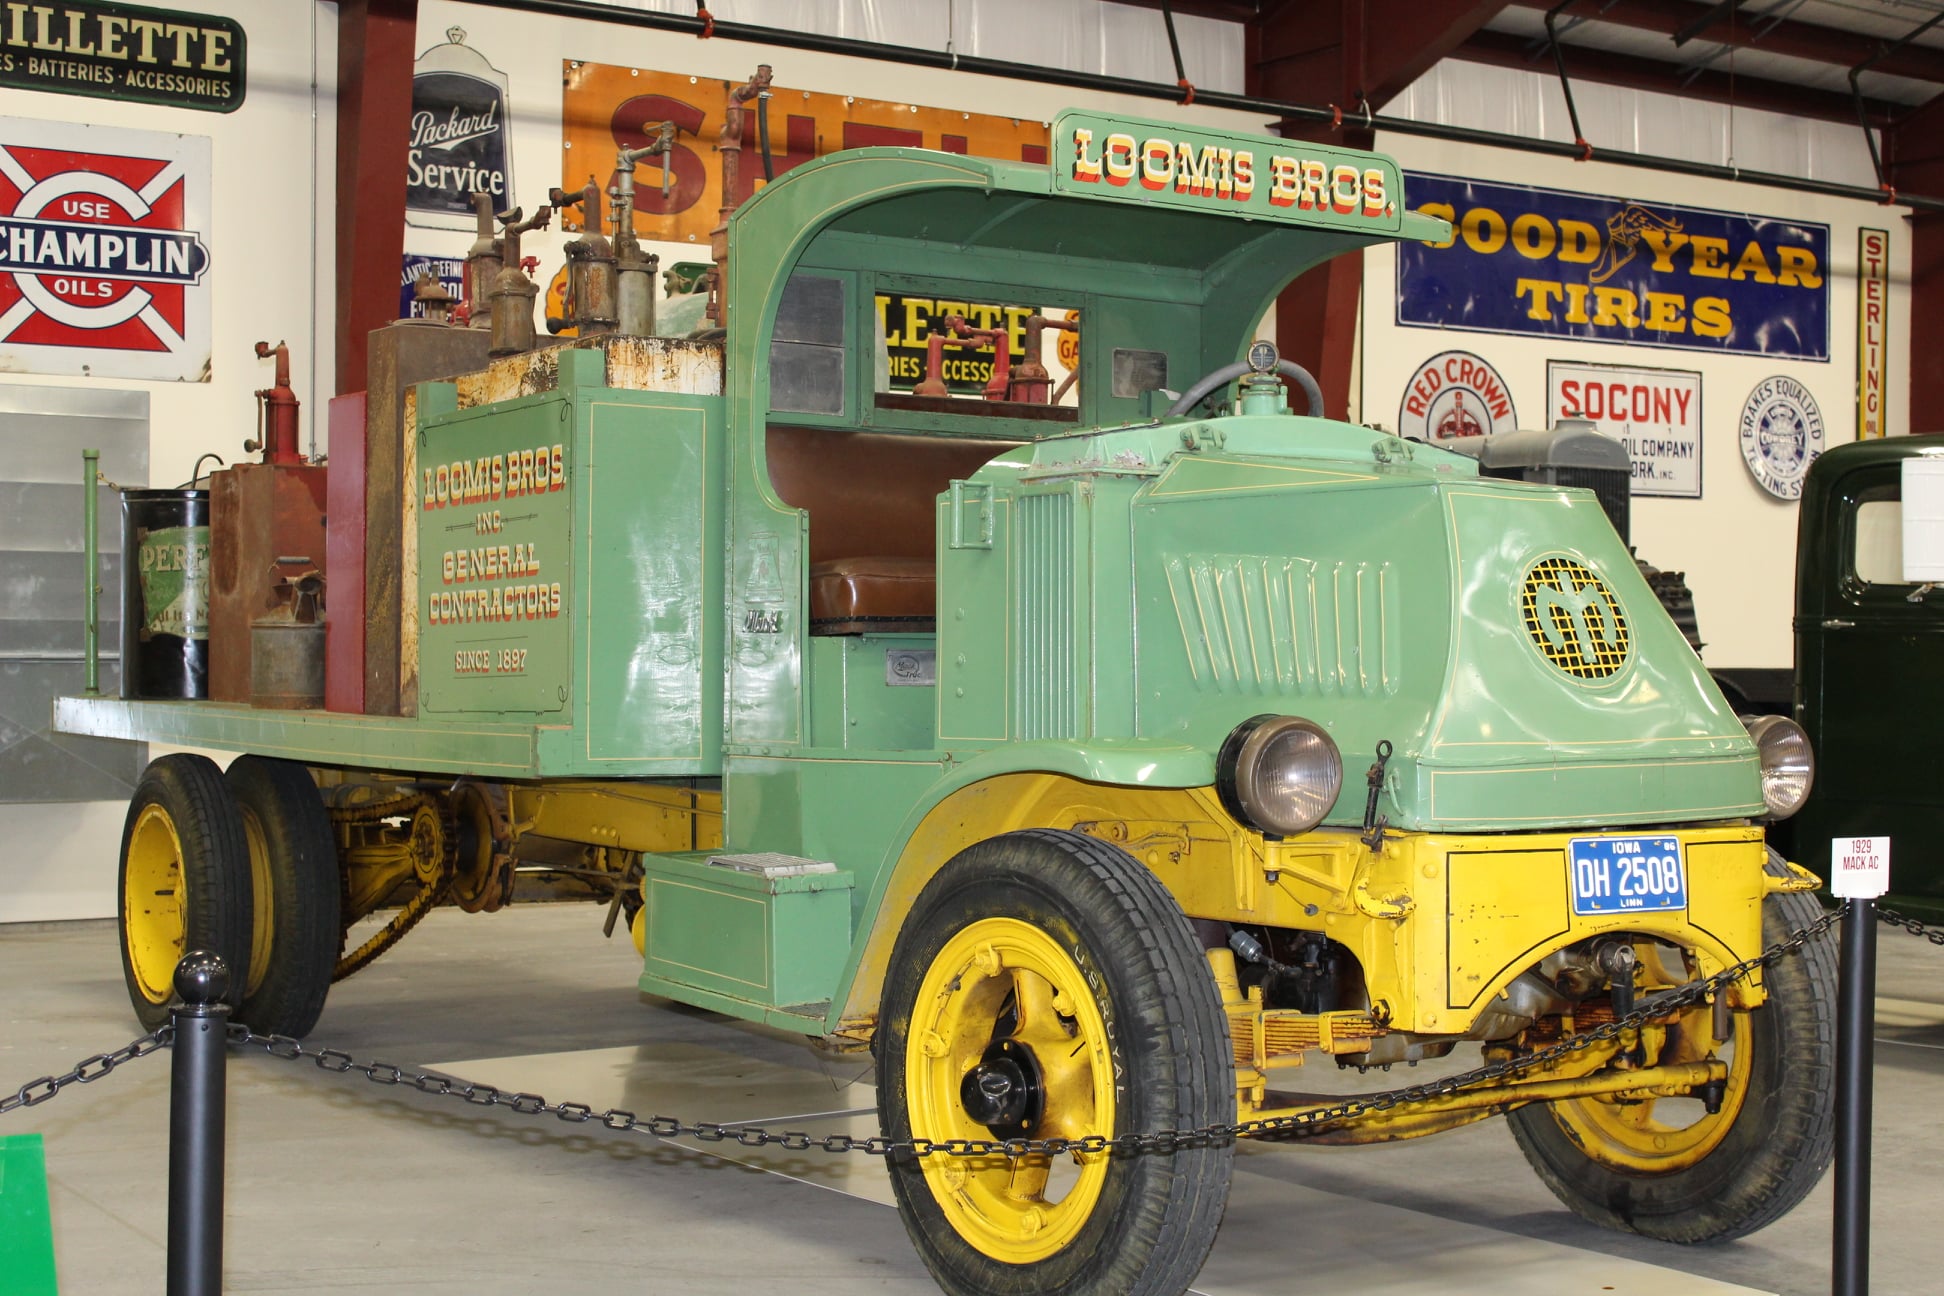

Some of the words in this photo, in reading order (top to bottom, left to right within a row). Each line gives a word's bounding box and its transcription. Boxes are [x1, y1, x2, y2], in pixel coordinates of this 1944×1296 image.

[0, 2, 232, 74] ILLETTE
[28, 56, 114, 84] BATTERIES
[126, 68, 231, 98] ACCESSORIES
[409, 99, 499, 150] Packard
[407, 149, 504, 195] Service
[1073, 128, 1255, 202] LOOMIS
[1269, 155, 1396, 218] BROS.
[63, 200, 110, 219] USE
[1641, 229, 1823, 289] YEAR
[54, 279, 113, 298] OILS
[1516, 278, 1733, 338] TIRES
[1865, 235, 1882, 413] STERLING
[1406, 367, 1442, 419] RED
[1445, 358, 1510, 420] CROWN
[1561, 380, 1692, 426] SOCONY
[1743, 382, 1773, 438] BRAKES
[1776, 380, 1822, 440] EQUALIZED
[1642, 439, 1694, 459] COMPANY
[423, 454, 503, 511] LOOMIS
[505, 444, 567, 499] BROS.
[442, 543, 540, 585] GENERAL
[429, 582, 561, 625] CONTRACTORS
[454, 650, 490, 673] SINCE
[496, 648, 527, 672] 1897
[1612, 841, 1641, 854] IOWA
[1843, 856, 1866, 870] MACK
[1868, 855, 1879, 870] AC
[1852, 839, 1872, 854] 1929
[1577, 858, 1611, 898] DH
[1617, 856, 1679, 896] 2508
[1620, 898, 1643, 908] LINN
